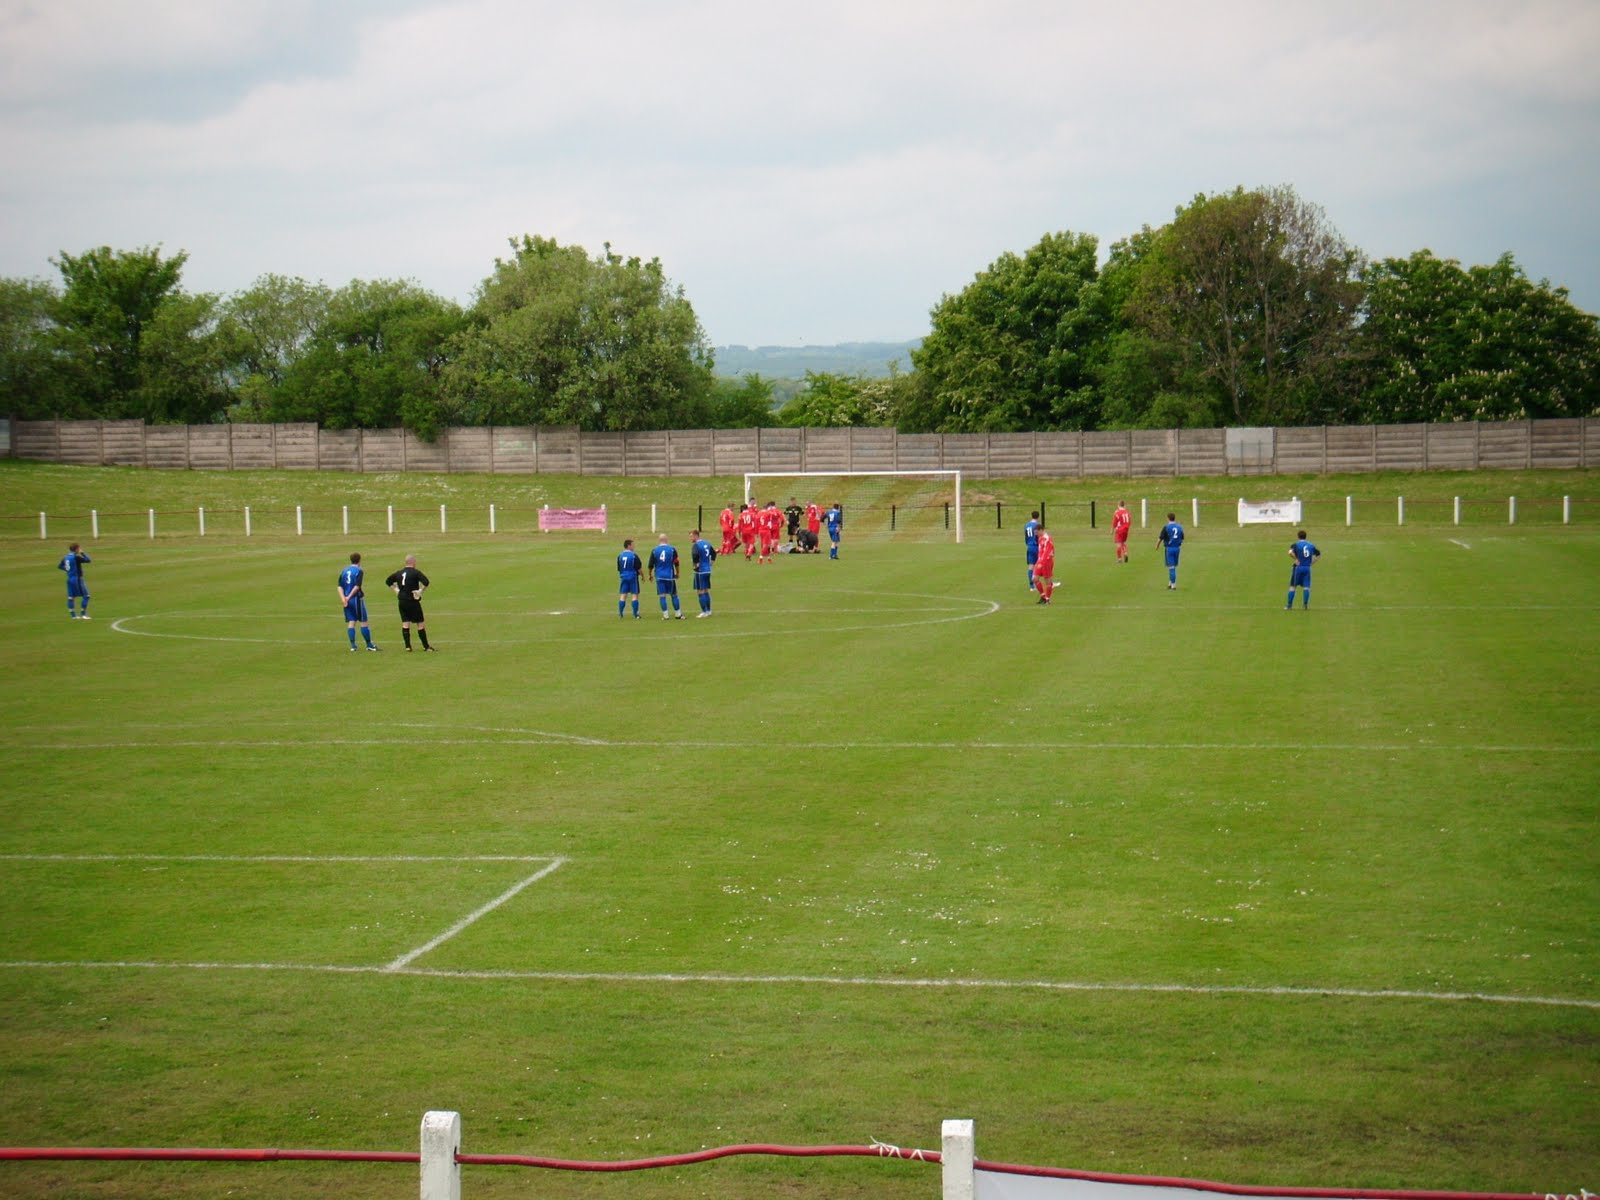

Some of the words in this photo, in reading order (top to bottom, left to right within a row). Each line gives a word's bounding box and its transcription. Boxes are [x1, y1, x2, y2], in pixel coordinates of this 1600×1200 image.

[743, 515, 752, 525] 10
[1026, 526, 1033, 538] 11
[1172, 527, 1178, 539] 2
[659, 550, 666, 562] 4
[704, 545, 710, 557] 5
[1303, 545, 1310, 558] 6
[622, 557, 628, 569] 7
[346, 570, 352, 584] 3
[401, 572, 407, 586] 1
